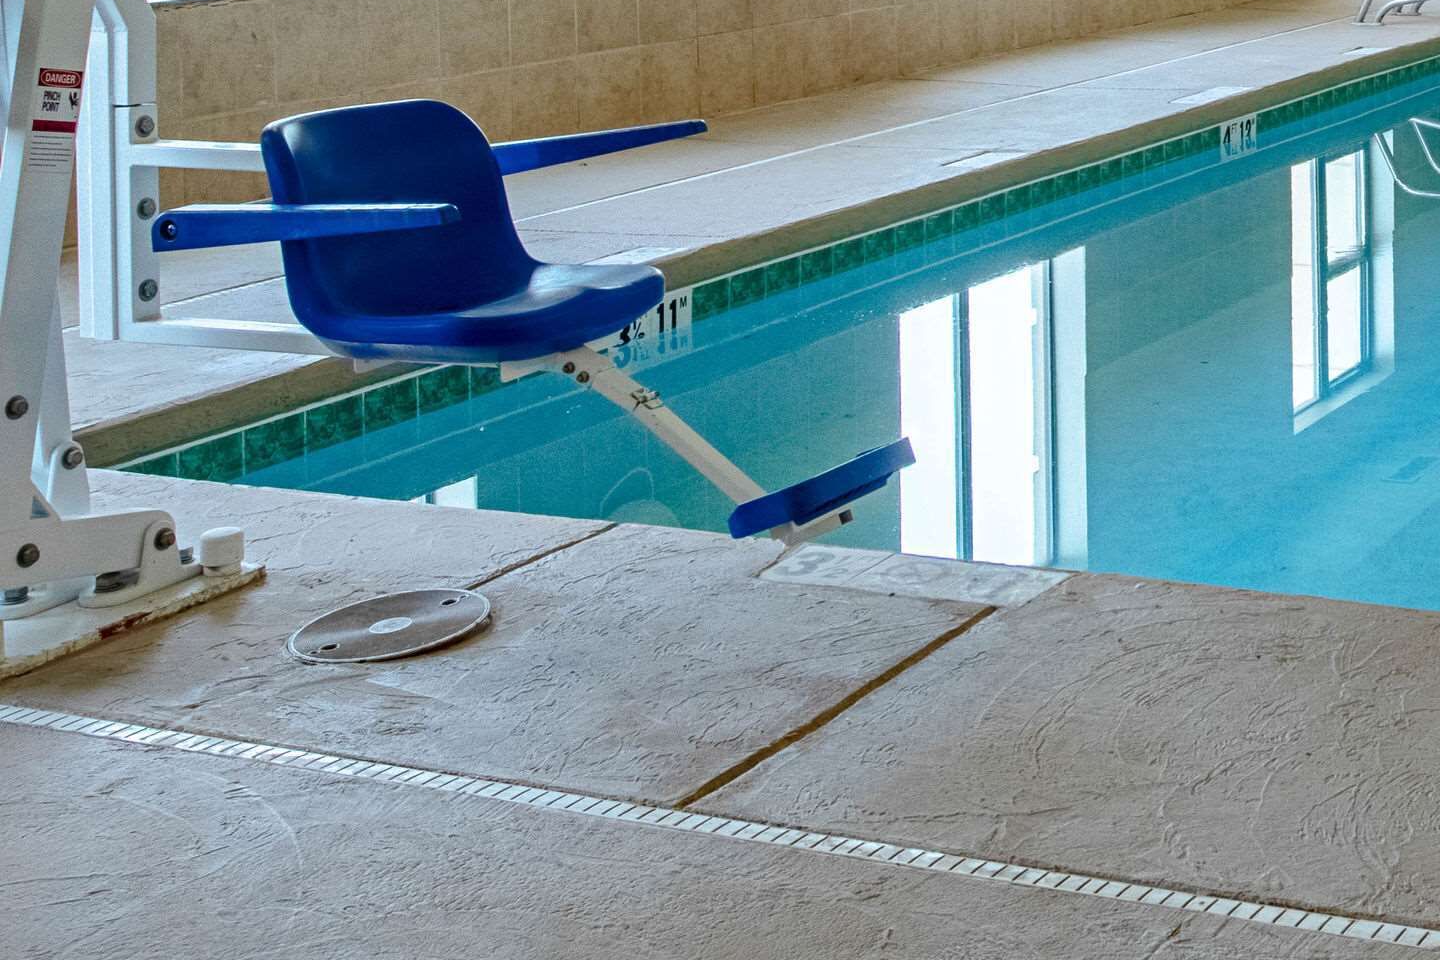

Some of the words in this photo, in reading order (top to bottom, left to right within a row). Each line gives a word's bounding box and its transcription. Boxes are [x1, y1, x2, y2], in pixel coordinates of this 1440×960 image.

[45, 72, 77, 85] DANGER
[43, 90, 61, 101] PINCH
[42, 101, 60, 113] POINT
